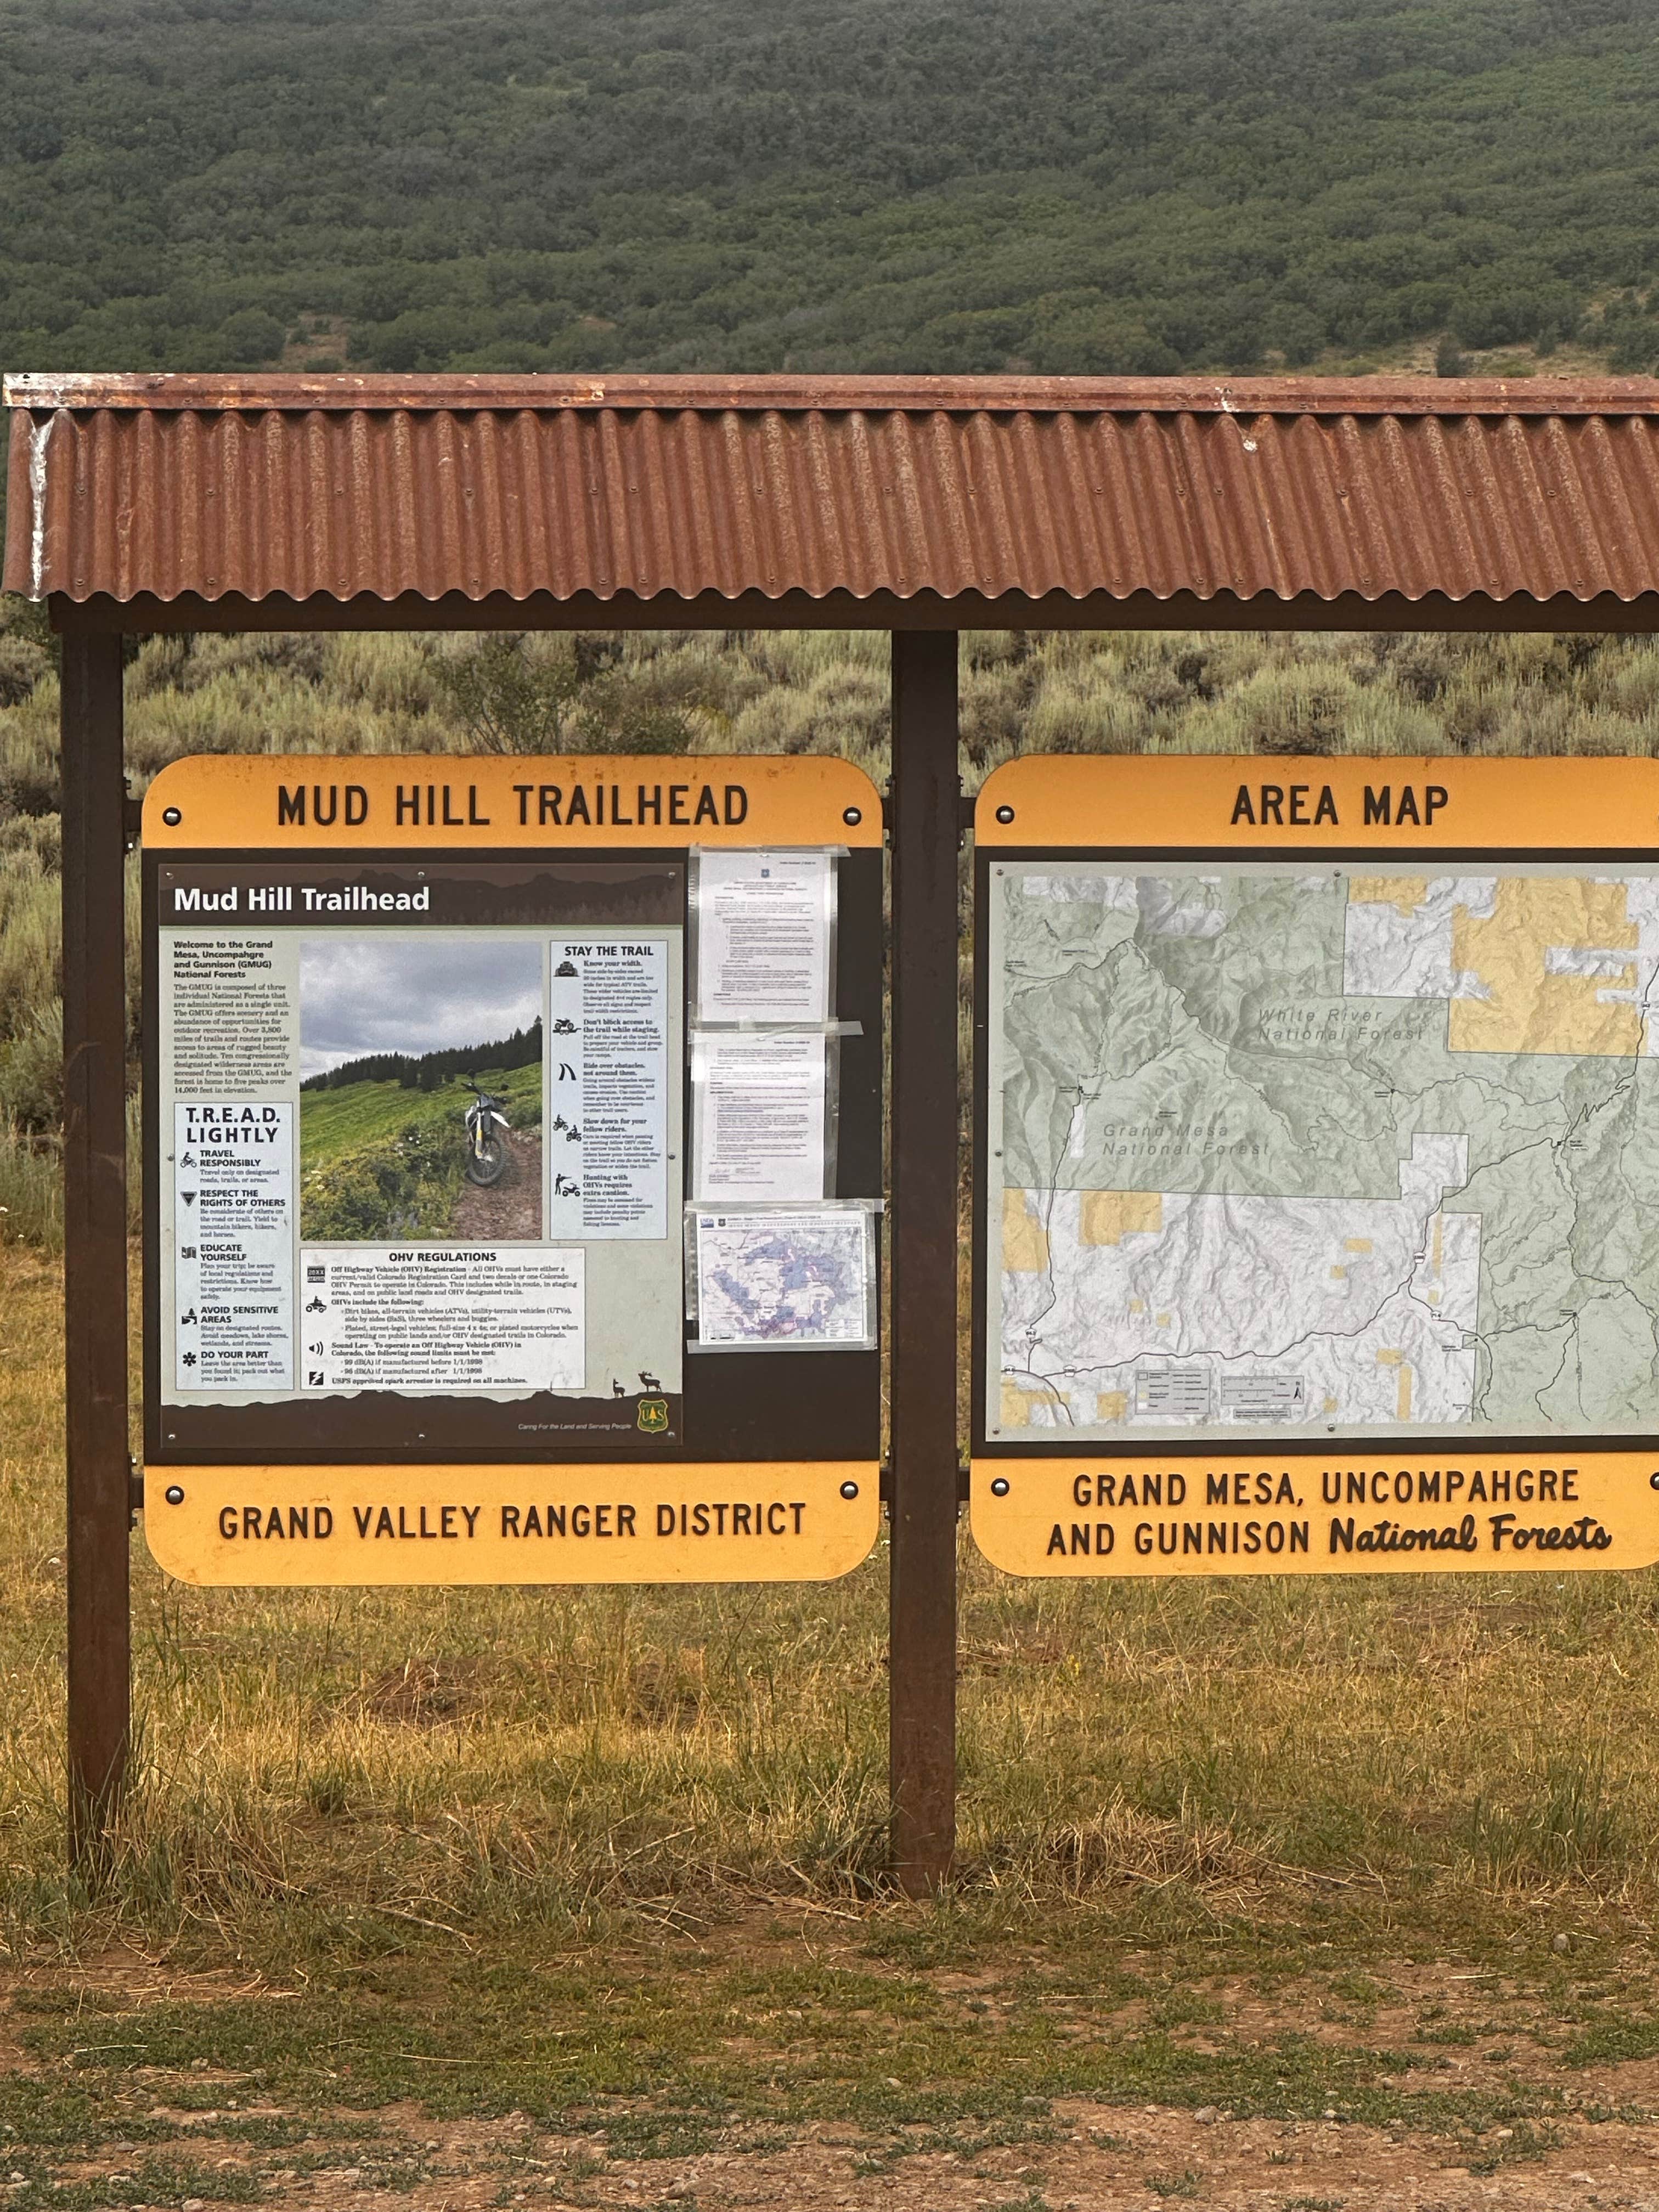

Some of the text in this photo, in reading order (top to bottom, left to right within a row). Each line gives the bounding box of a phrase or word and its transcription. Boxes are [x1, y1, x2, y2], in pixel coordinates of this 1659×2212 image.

[278, 785, 748, 826] MUD HILL TRAILHEAD
[1232, 785, 1448, 825] AREA MAP
[175, 887, 428, 910] Mud Hill Trailhead
[202, 951, 264, 960] Uncompahgre
[565, 946, 653, 956] STAY THE TRAIL
[1259, 1008, 1382, 1022] White River
[1259, 1026, 1423, 1040] National Forest
[186, 1108, 280, 1122] T.R.E.A.D.
[187, 1128, 277, 1143] LIGHTLY
[1103, 1124, 1228, 1137] Grand Mesa
[1103, 1142, 1268, 1155] National Forest
[389, 1253, 496, 1261] OHV REGULATIONS
[1074, 1470, 1578, 1507] GRAND MESA, UNCOMPAHGRE
[219, 1503, 805, 1539] GRAND VALLEY RANGER DISTRICT
[1047, 1514, 1612, 1555] AND GUNNISON National Forests
